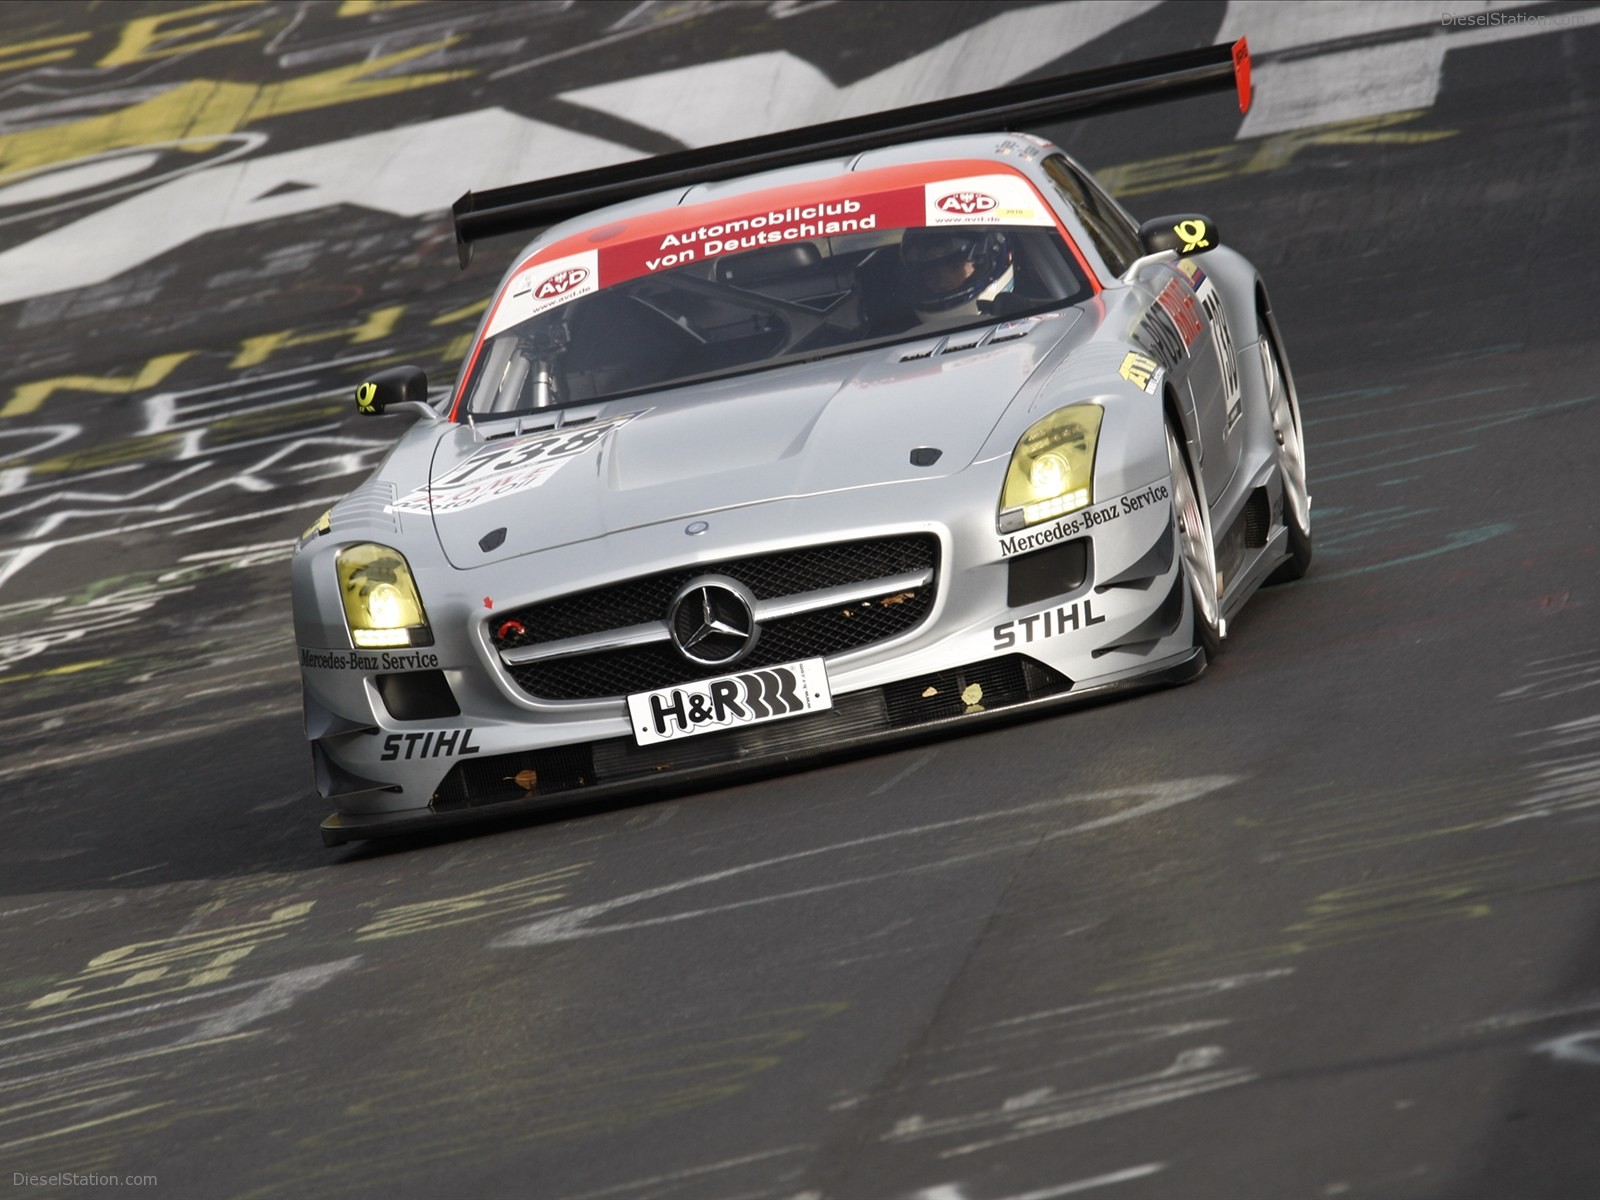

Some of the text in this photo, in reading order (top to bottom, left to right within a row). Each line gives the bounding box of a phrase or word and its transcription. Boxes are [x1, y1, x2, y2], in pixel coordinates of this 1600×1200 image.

[645, 214, 877, 270] von Deutschland
[660, 199, 861, 250] Automobilclub
[533, 286, 591, 313] www.avd.de
[445, 423, 617, 485] 738
[999, 484, 1169, 557] Mercedes-Benz Service
[993, 599, 1106, 651] STIHL
[301, 649, 439, 670] Mercedes-Benz Service
[649, 680, 747, 734] H&R
[380, 728, 481, 762] STIHL
